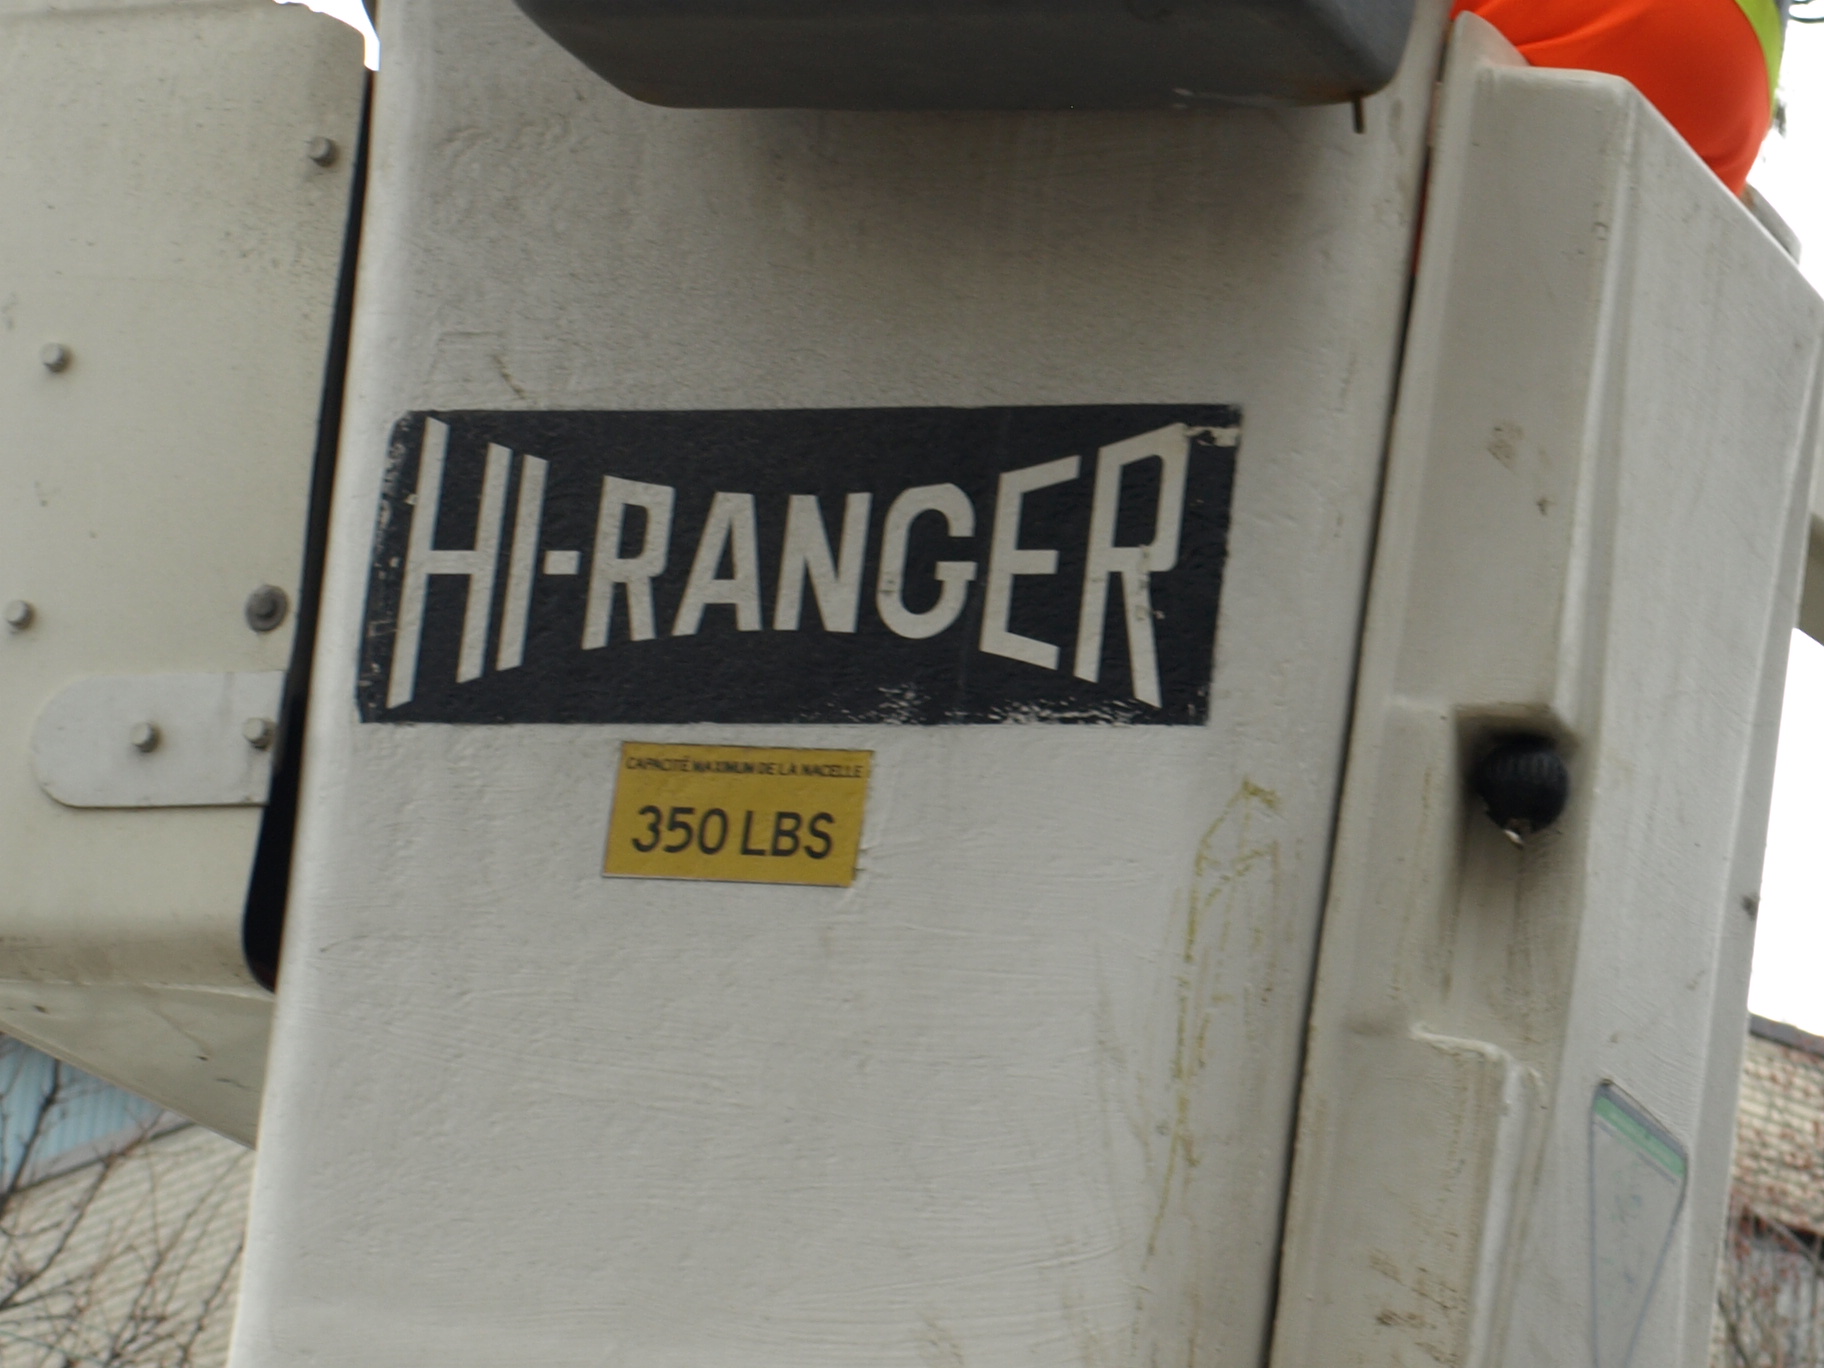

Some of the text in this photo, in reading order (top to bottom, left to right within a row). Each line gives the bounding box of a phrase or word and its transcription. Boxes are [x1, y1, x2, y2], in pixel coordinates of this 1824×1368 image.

[387, 417, 1188, 709] HI-RANGER
[631, 805, 835, 860] 350 LBS
